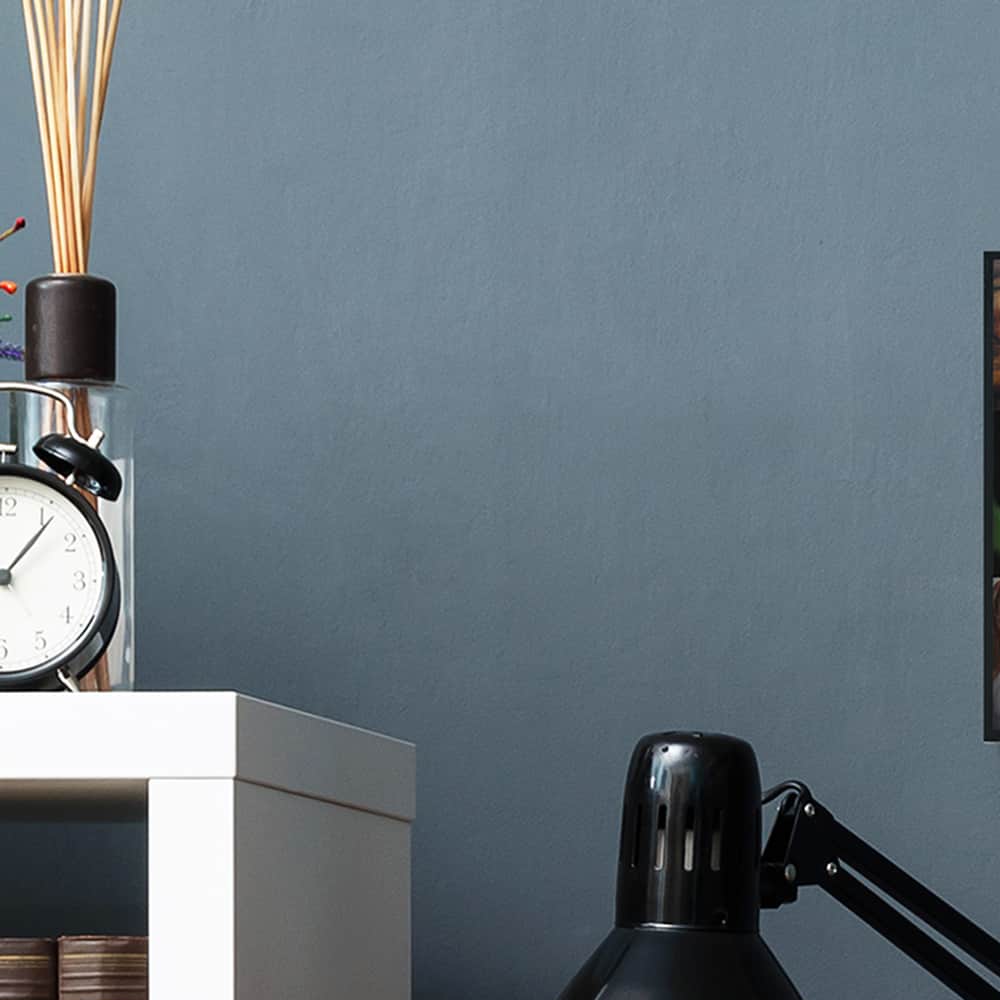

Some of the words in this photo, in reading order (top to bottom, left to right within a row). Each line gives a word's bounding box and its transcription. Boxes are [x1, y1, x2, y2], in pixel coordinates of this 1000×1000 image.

[39, 507, 45, 526] 1
[64, 533, 77, 553] 2
[73, 571, 86, 591] 3
[60, 605, 73, 624] 4
[34, 631, 47, 651] 5
